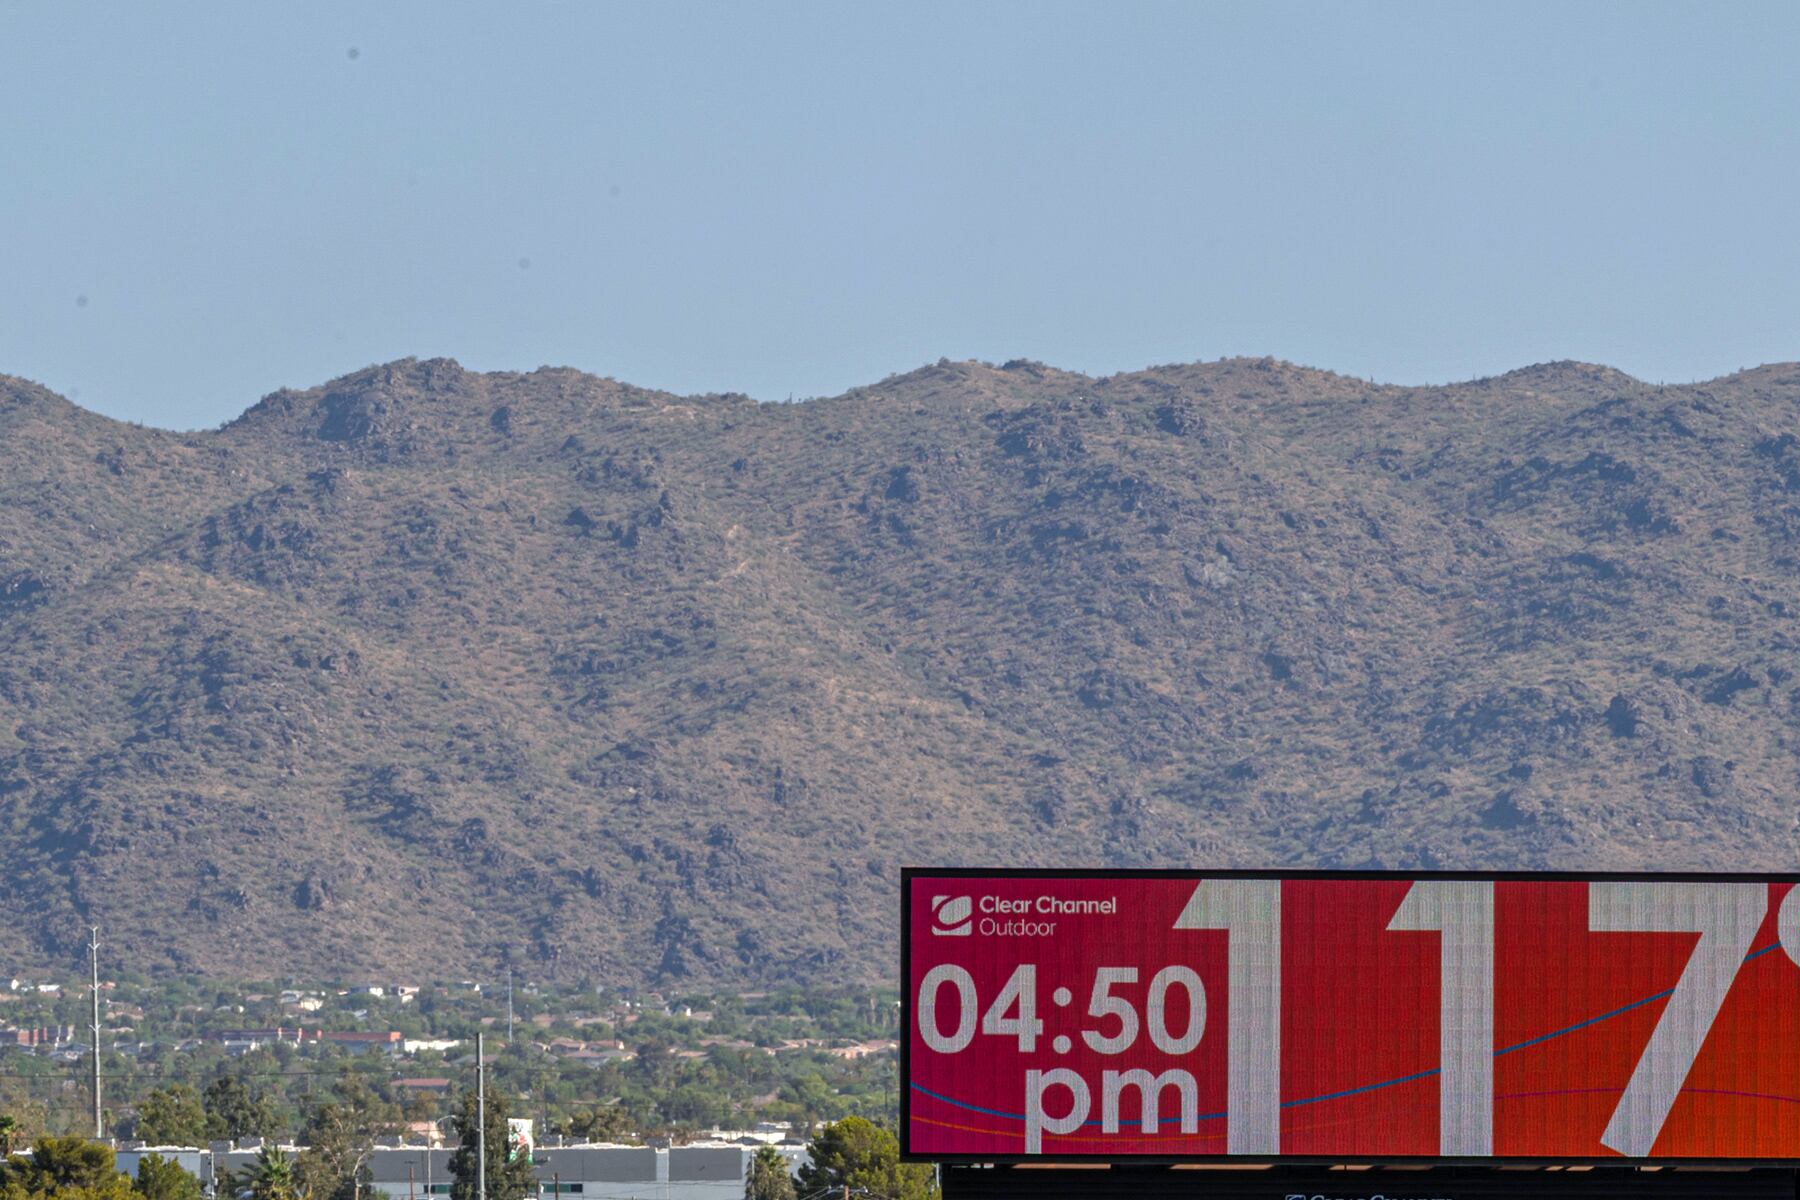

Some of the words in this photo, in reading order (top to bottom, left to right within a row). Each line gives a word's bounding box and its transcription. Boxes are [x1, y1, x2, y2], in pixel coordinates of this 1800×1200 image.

[979, 895, 1033, 914] Clear
[1035, 895, 1117, 914] Channel
[979, 917, 1057, 937] Outdoor
[917, 963, 1207, 1055] 04:50
[1024, 1067, 1199, 1155] pm
